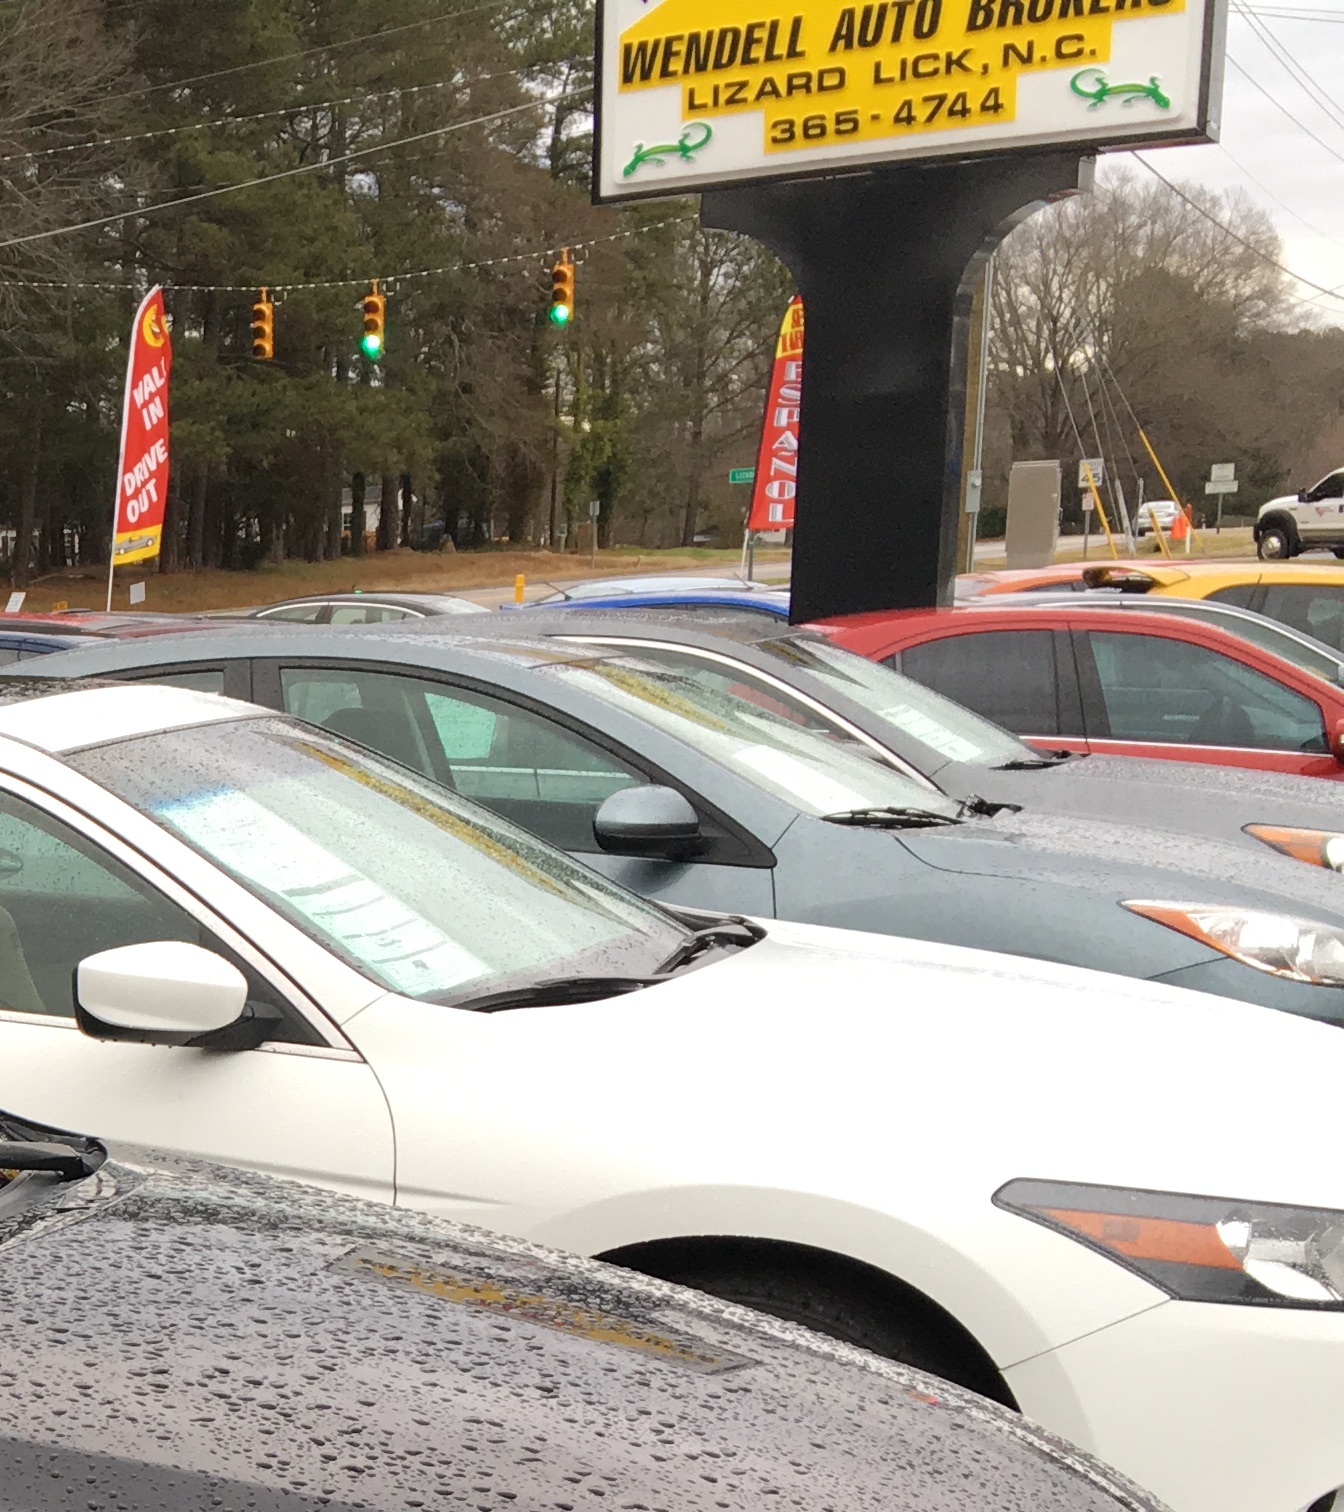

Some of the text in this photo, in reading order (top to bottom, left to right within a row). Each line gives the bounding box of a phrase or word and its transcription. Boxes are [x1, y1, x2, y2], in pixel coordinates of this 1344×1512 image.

[621, 0, 1174, 85] WENDELL AUTO BROK
[687, 33, 1098, 111] LIZARD LICK, N.C.
[133, 356, 167, 410] WAL
[142, 395, 165, 431] IN
[124, 438, 169, 497] DRIVE
[127, 478, 159, 524] OUT
